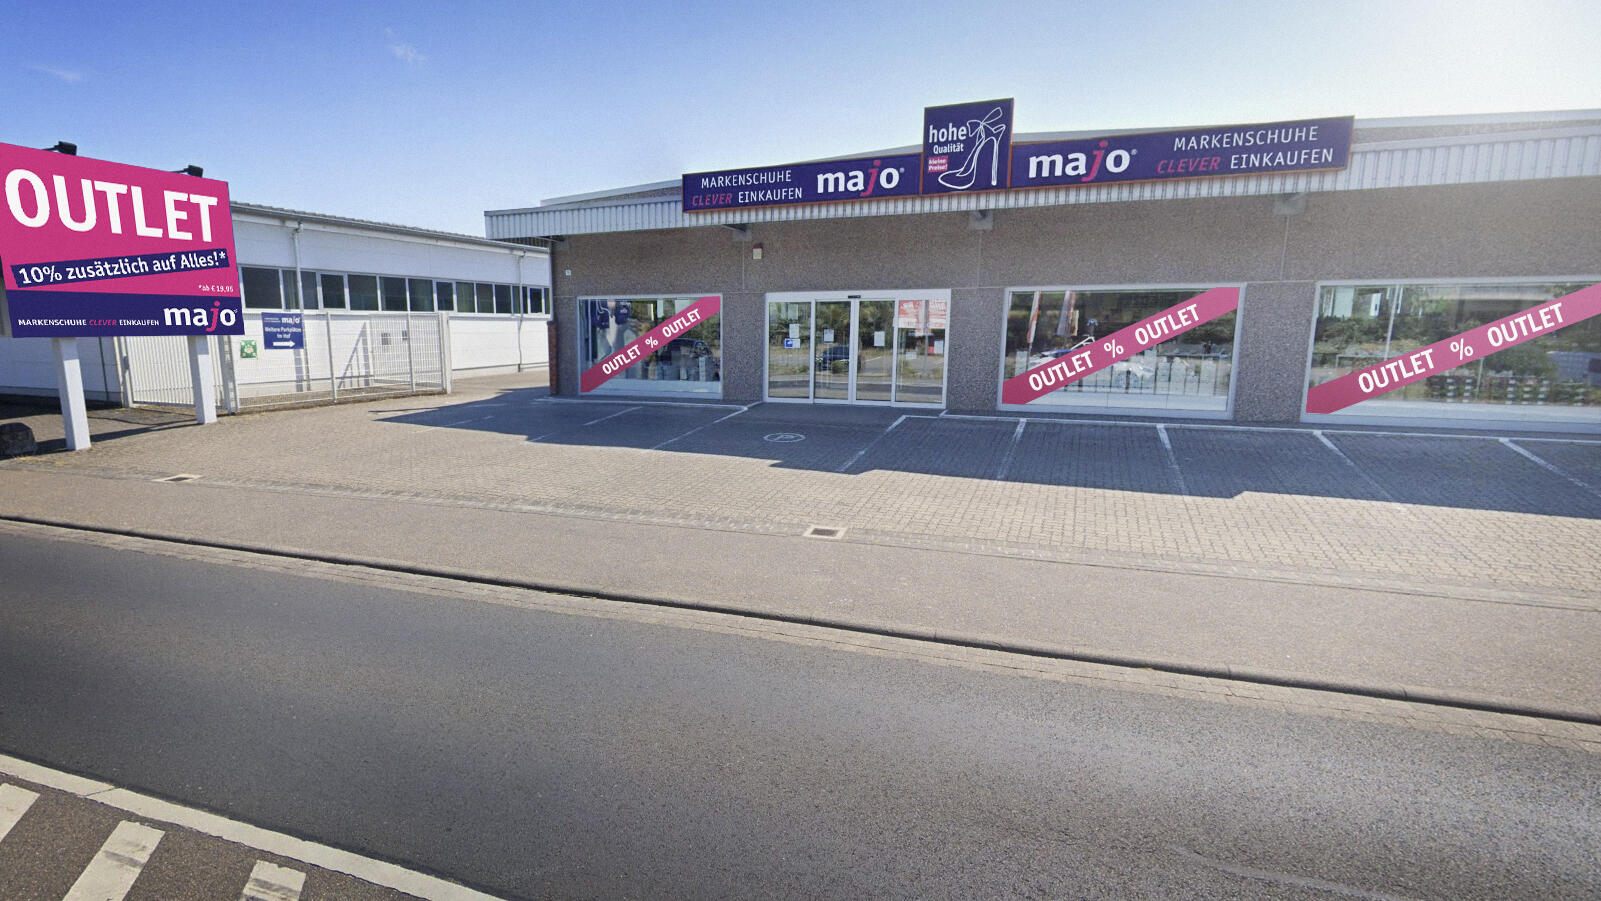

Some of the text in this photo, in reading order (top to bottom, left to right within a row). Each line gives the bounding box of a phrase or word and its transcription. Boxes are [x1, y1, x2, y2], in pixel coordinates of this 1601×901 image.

[929, 122, 967, 143] hohe
[1173, 126, 1319, 151] MARKENSCHUHE
[933, 142, 964, 154] Qualität
[1156, 148, 1334, 174] CLEVER EINKAUFEN
[701, 170, 792, 189] MARKENSCHUHE
[5, 168, 218, 242] OUTLET
[691, 187, 802, 206] CLEVER EINKAUFEN
[19, 265, 62, 284] 10%
[66, 256, 149, 280] zusätzlich
[152, 255, 176, 272] auf
[602, 308, 701, 375] OUTLET % OUTLET
[1028, 303, 1200, 392] OUTLET % OUTLET
[1358, 302, 1566, 394] OUTLET % OUTLET
